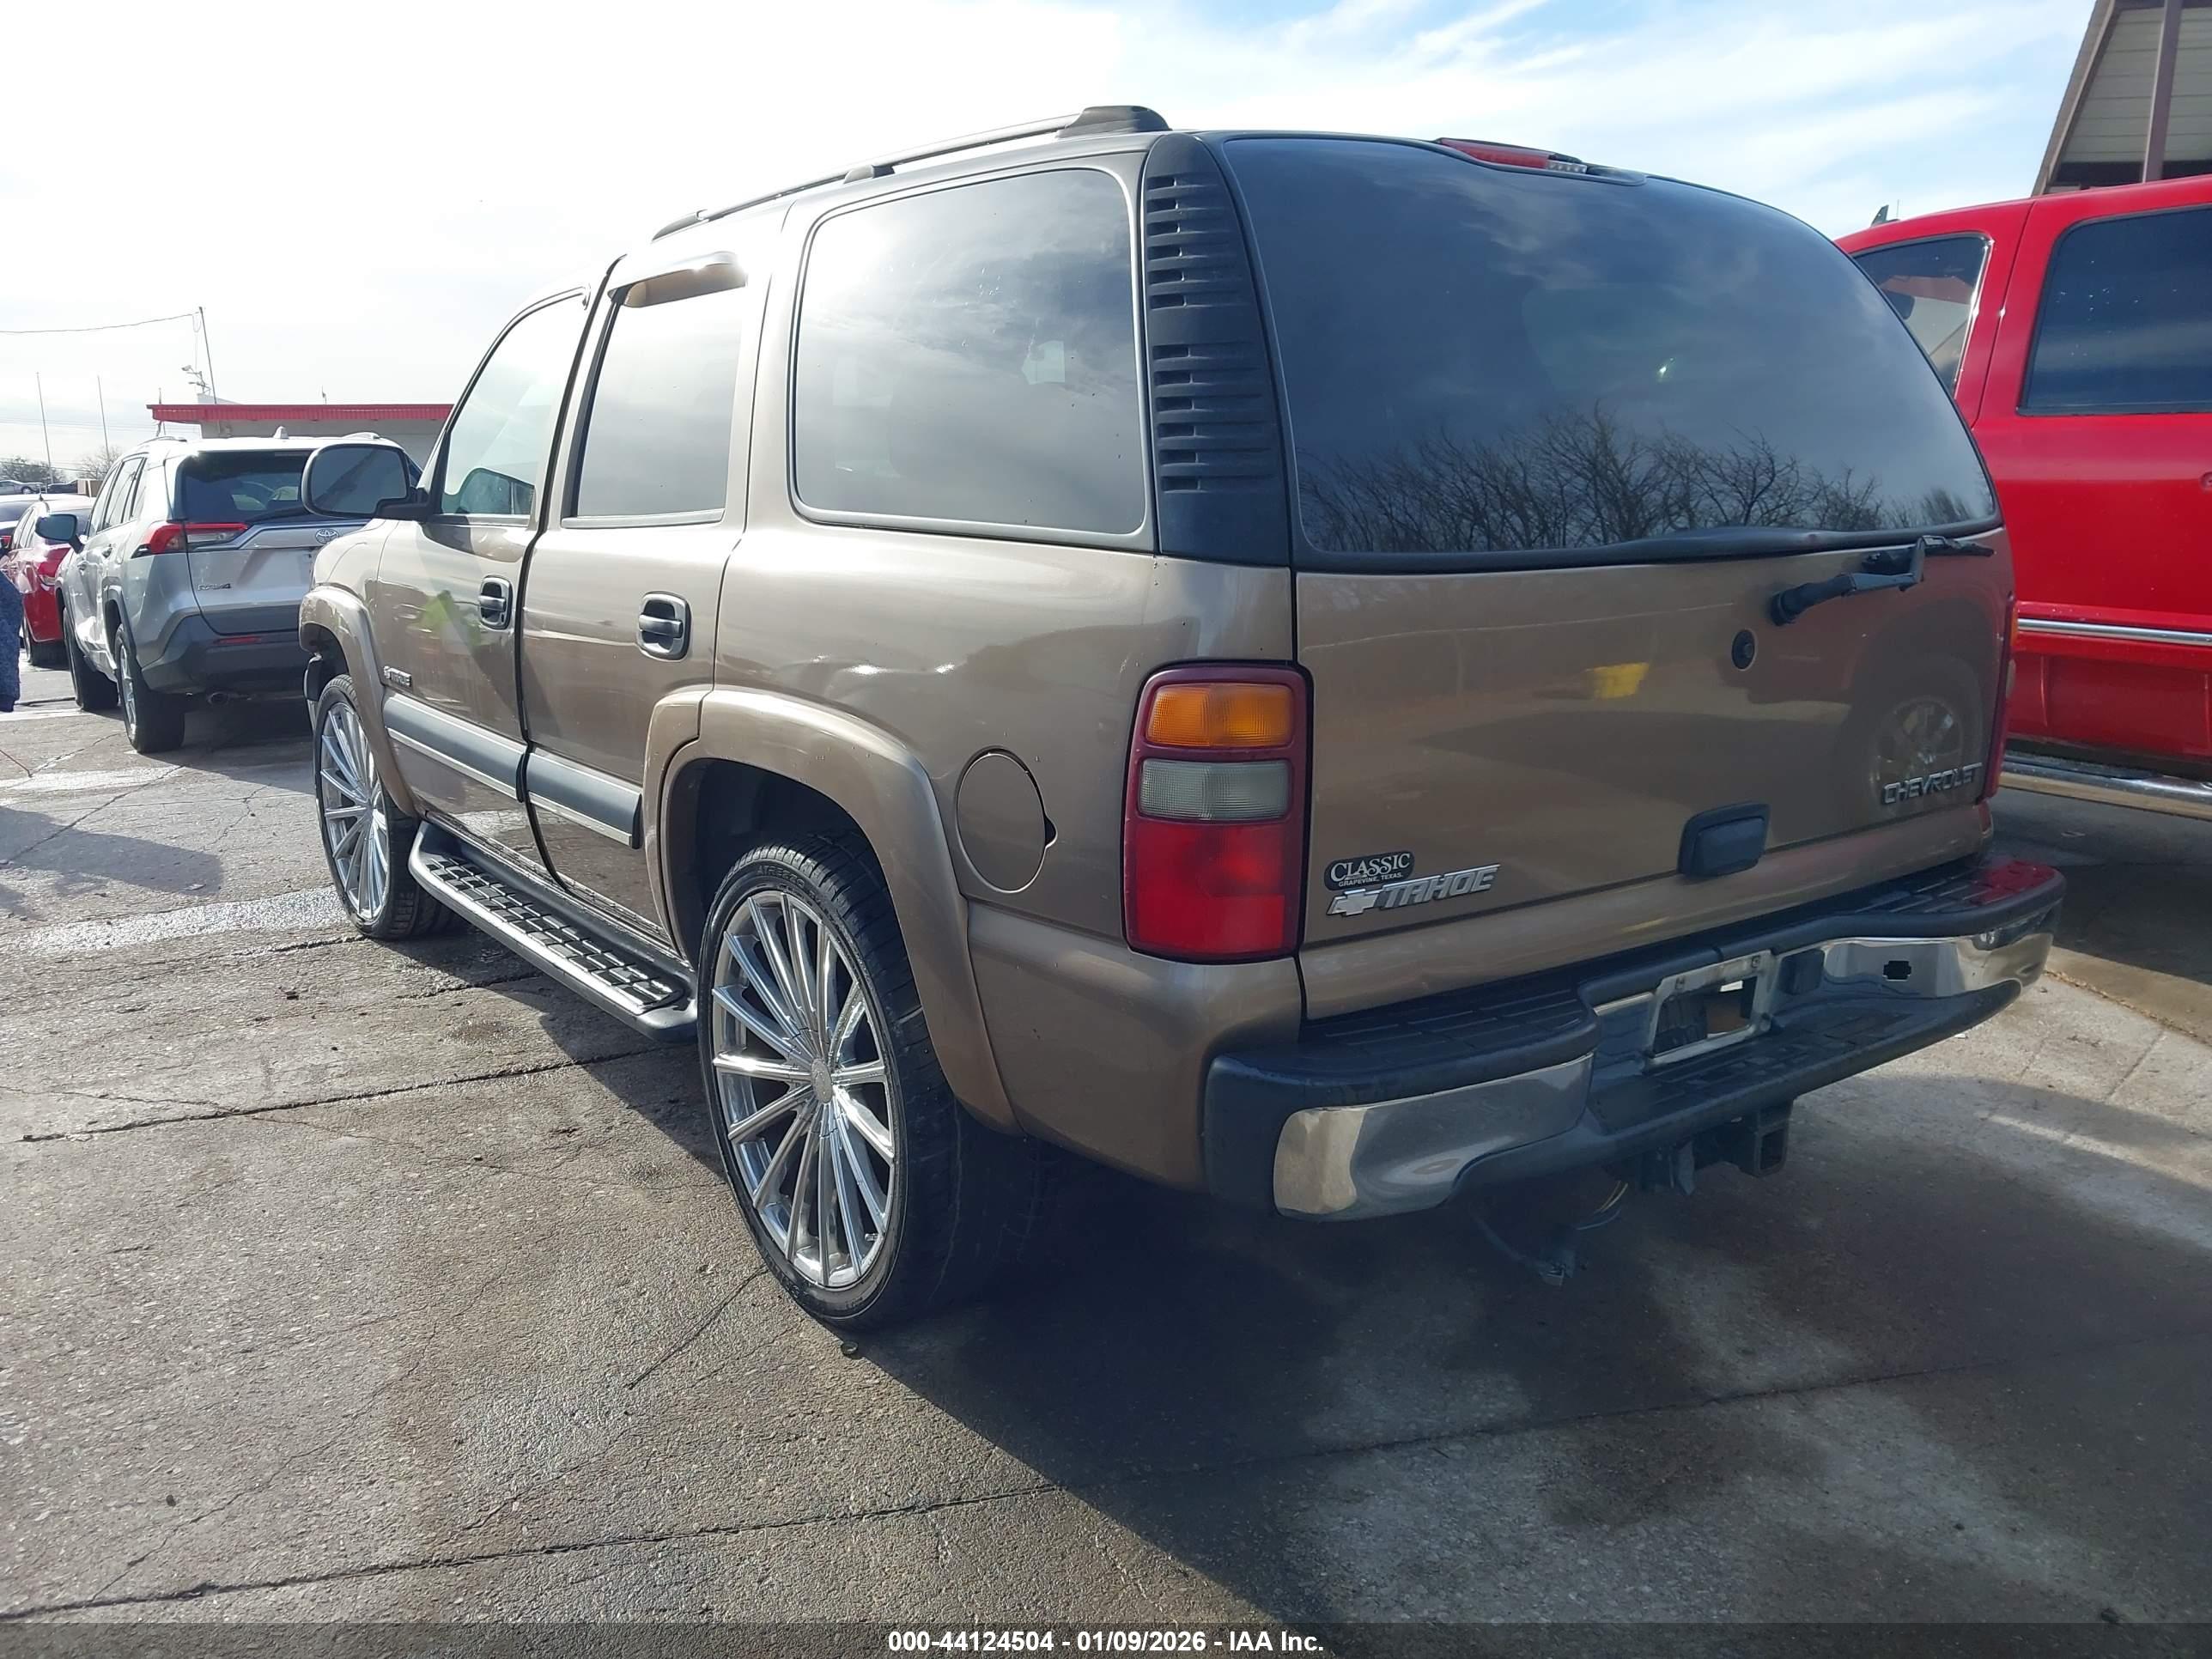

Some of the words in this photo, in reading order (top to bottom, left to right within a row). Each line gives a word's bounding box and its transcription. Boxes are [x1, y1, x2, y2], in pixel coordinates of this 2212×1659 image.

[1882, 762, 1983, 804] CHEVROLET
[1331, 853, 1410, 882] CLASSIC
[1381, 863, 1500, 909] TAHOE
